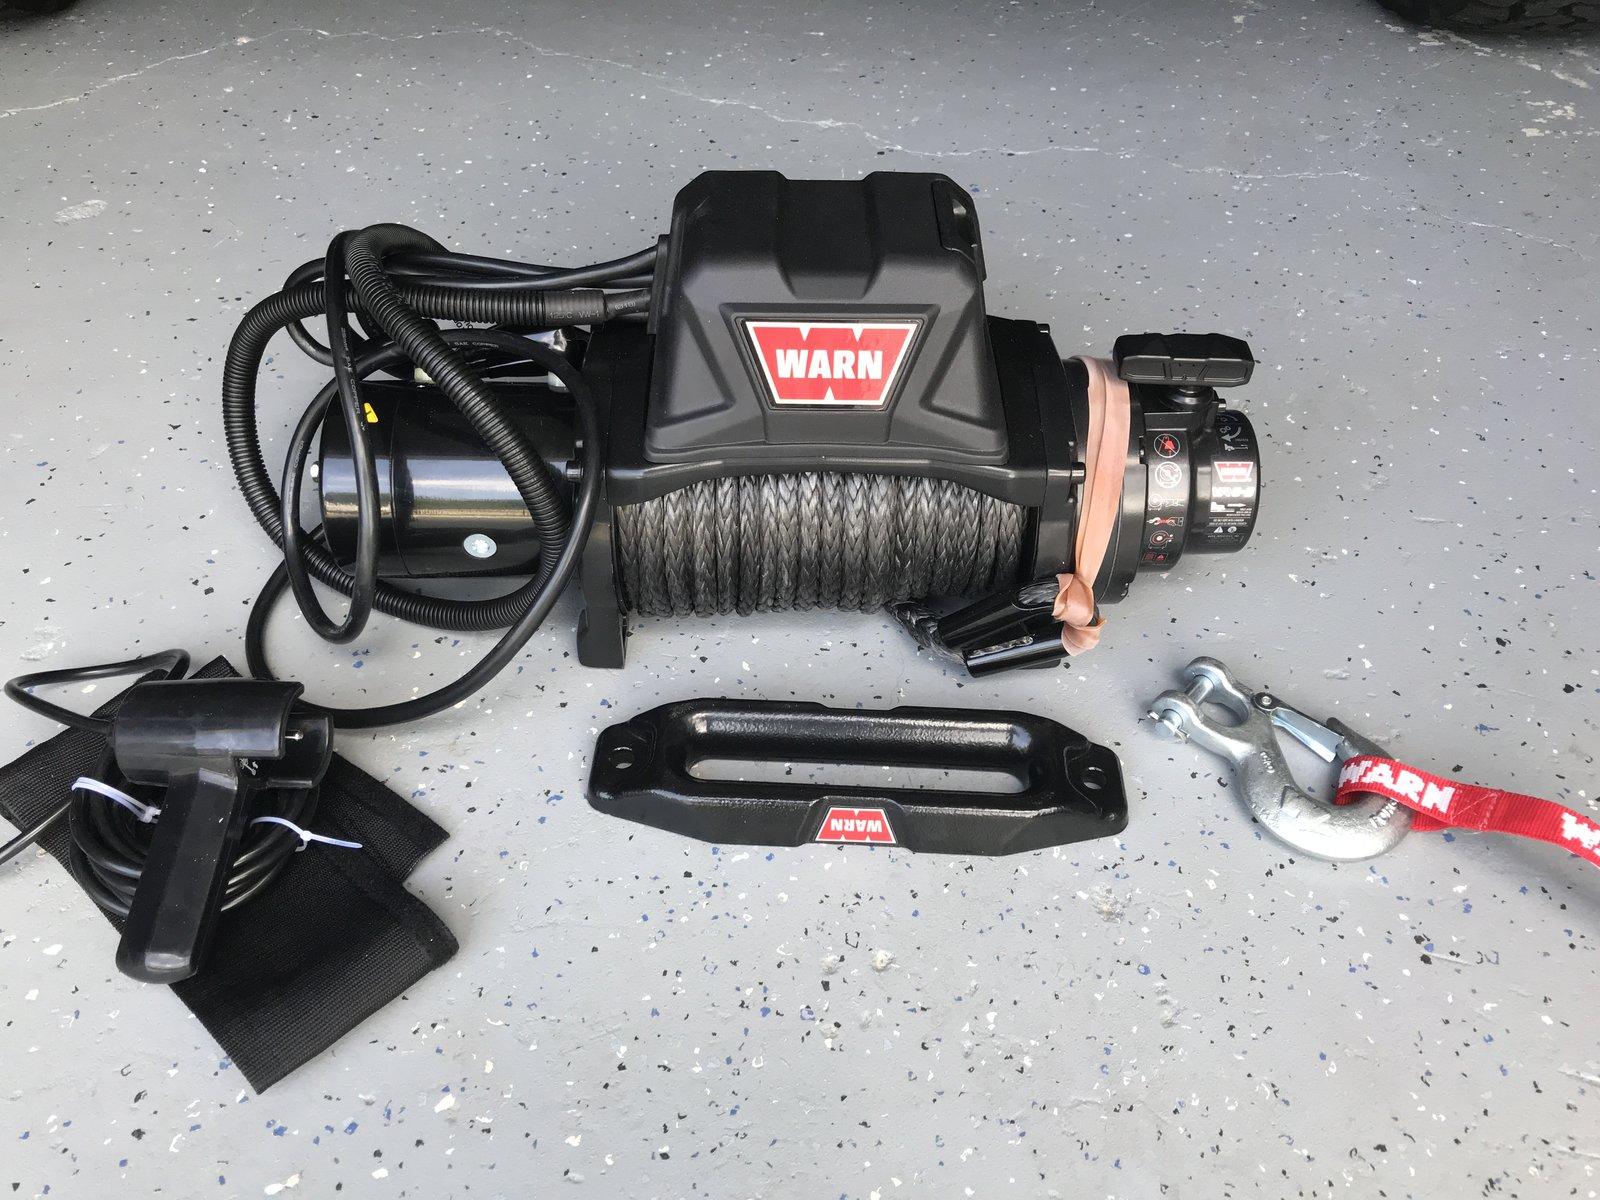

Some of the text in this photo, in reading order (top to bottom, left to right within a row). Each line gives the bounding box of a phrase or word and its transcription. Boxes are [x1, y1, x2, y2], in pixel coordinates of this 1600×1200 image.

[775, 348, 883, 380] WARN
[1338, 759, 1455, 813] WARN
[830, 818, 883, 833] WARN
